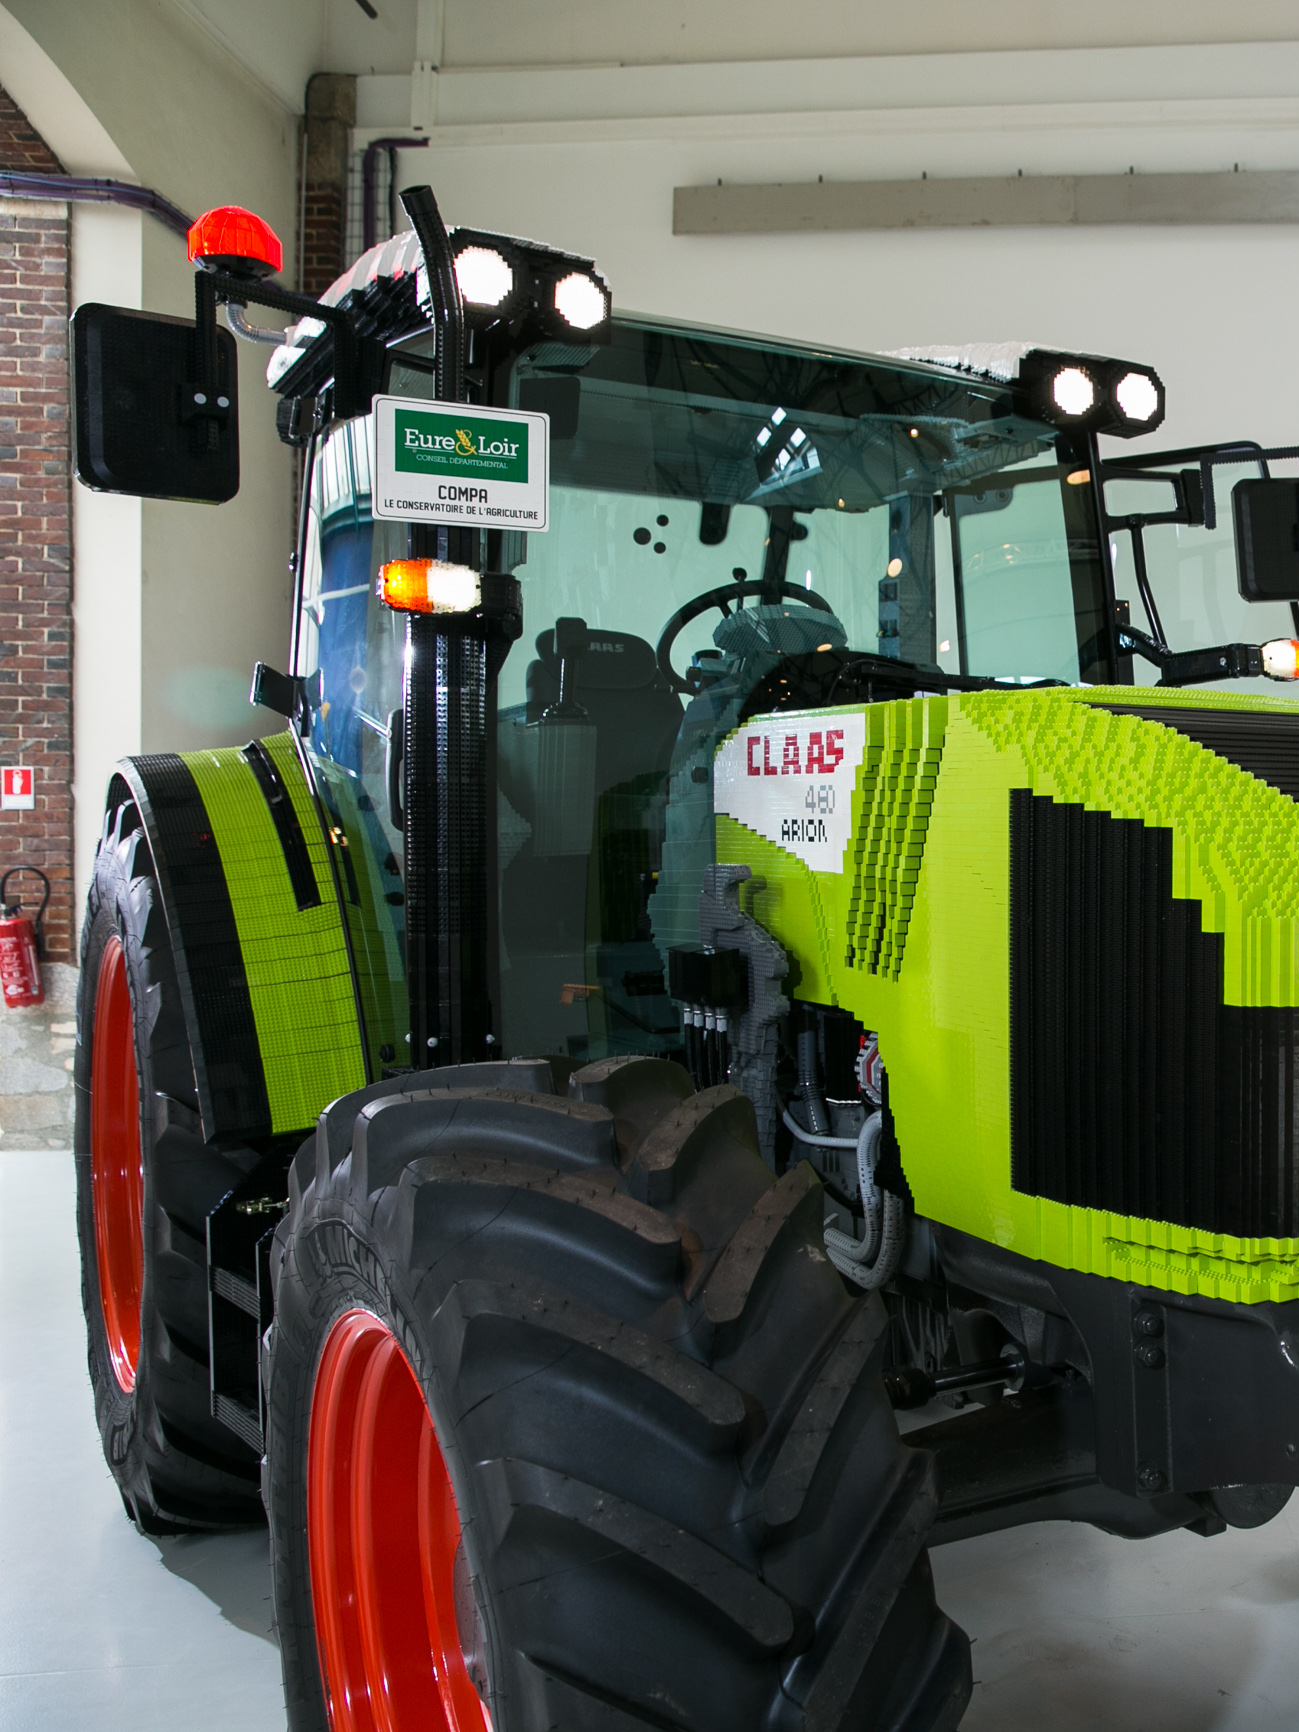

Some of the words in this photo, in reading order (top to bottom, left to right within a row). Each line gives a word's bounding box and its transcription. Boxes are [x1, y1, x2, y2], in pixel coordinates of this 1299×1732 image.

[416, 454, 448, 464] CONSEIL
[438, 485, 488, 503] COMPA
[384, 499, 394, 508] LE
[397, 500, 464, 514] CONSERVATOIRE
[466, 505, 476, 515] DE
[479, 506, 538, 520] L'AGRICULTURE
[747, 729, 844, 776] CLAAS
[781, 819, 828, 843] ARION
